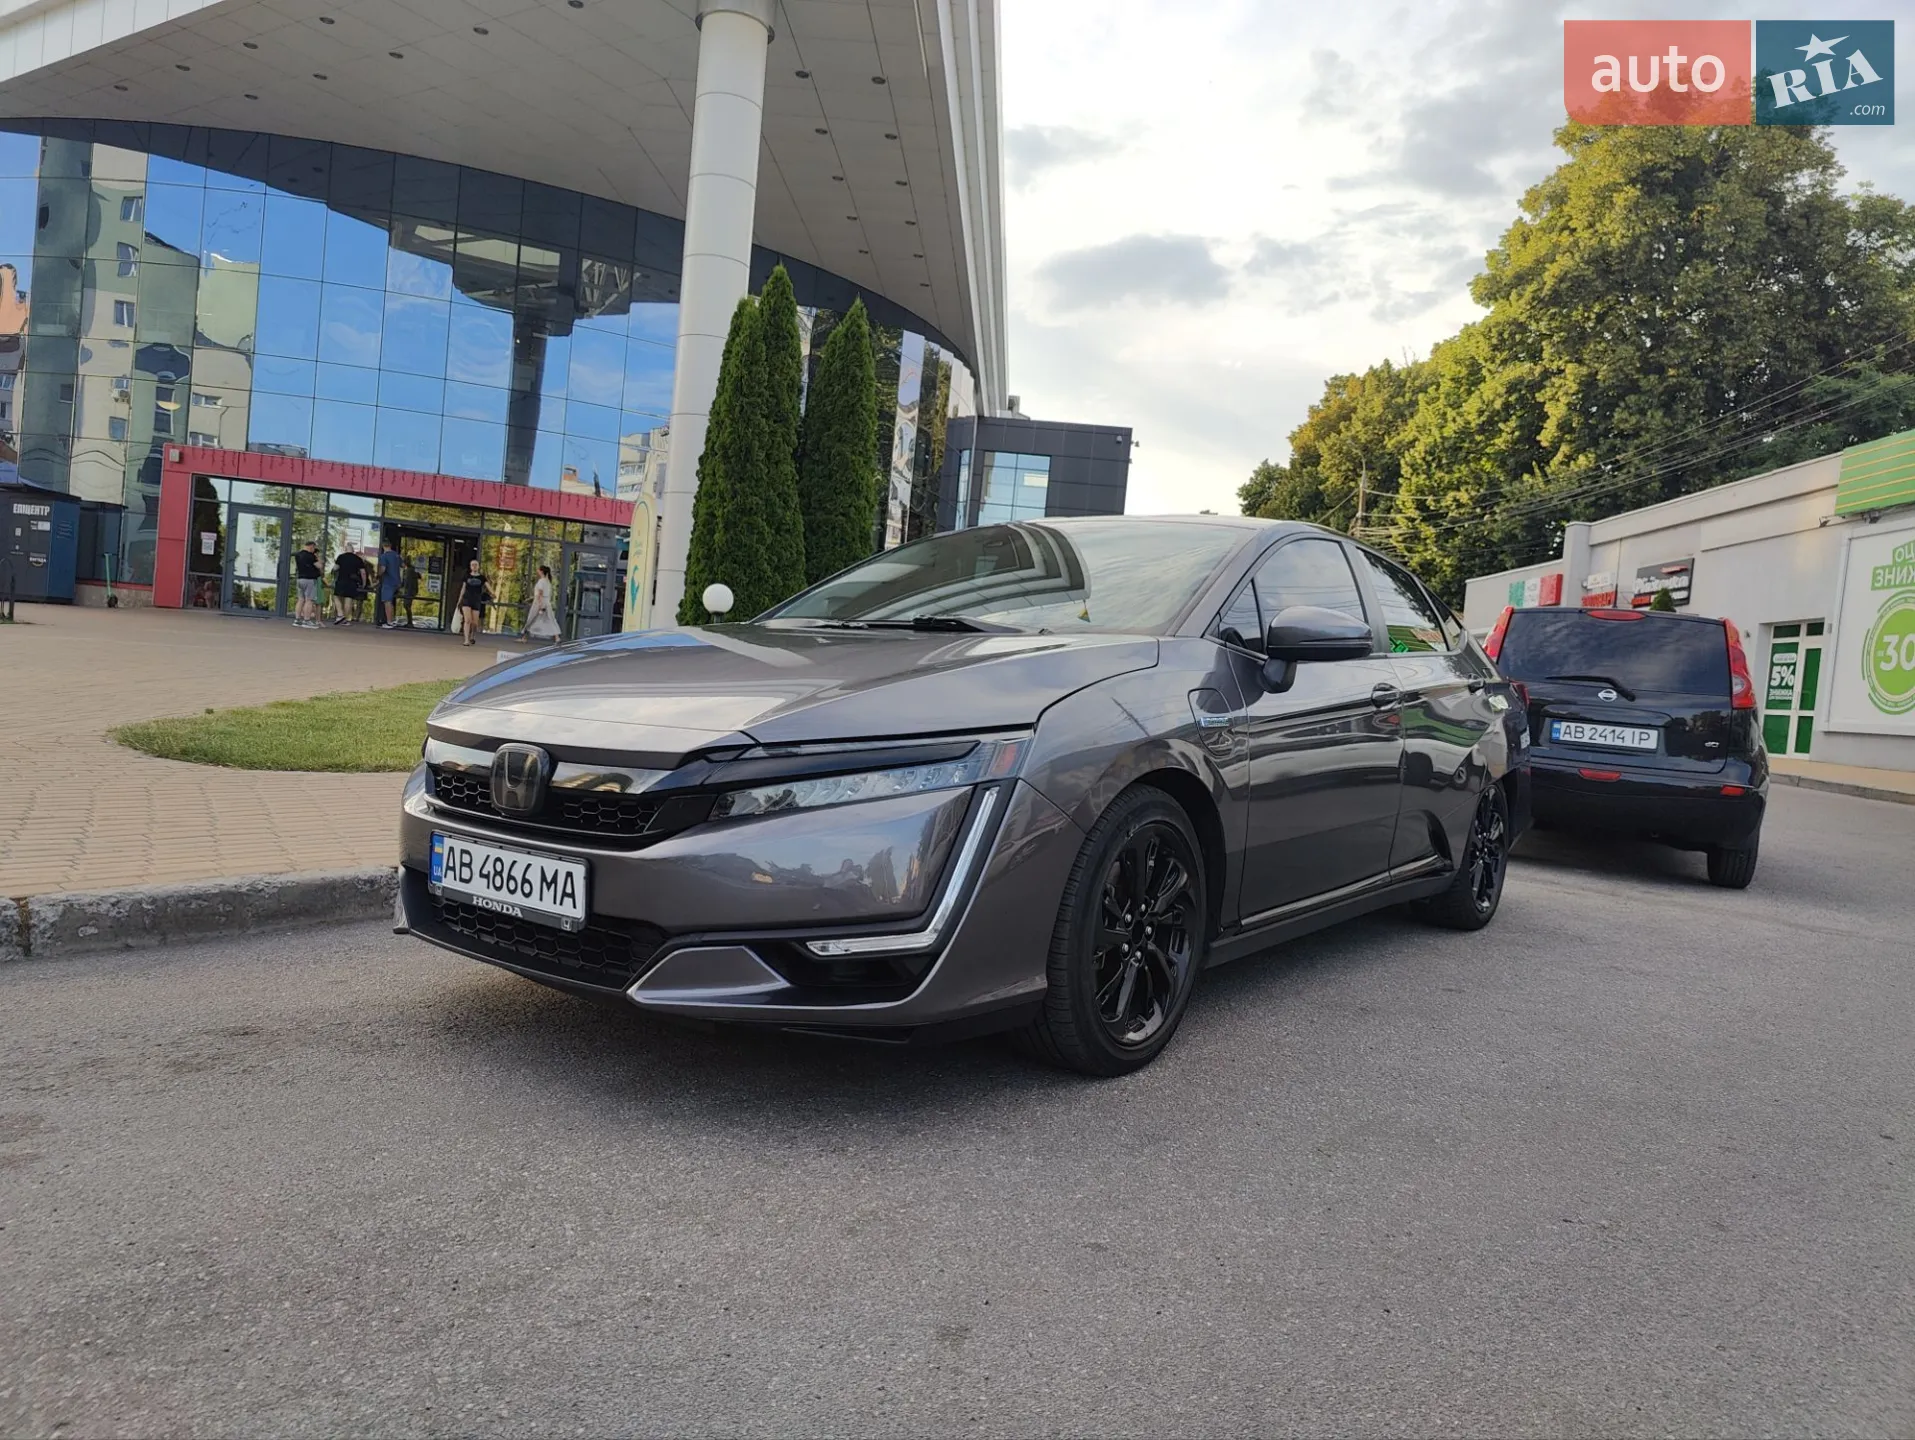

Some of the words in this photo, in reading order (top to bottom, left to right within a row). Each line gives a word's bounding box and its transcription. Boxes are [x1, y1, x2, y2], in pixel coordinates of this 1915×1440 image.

[1770, 665, 1795, 687] 5%
[1562, 724, 1585, 740] AB
[1588, 726, 1625, 743] 2414
[1631, 731, 1651, 745] IP
[433, 865, 442, 876] UA
[444, 846, 473, 884] AB
[479, 854, 533, 898] 4866
[539, 865, 577, 909] MA
[472, 896, 523, 918] HONDA
